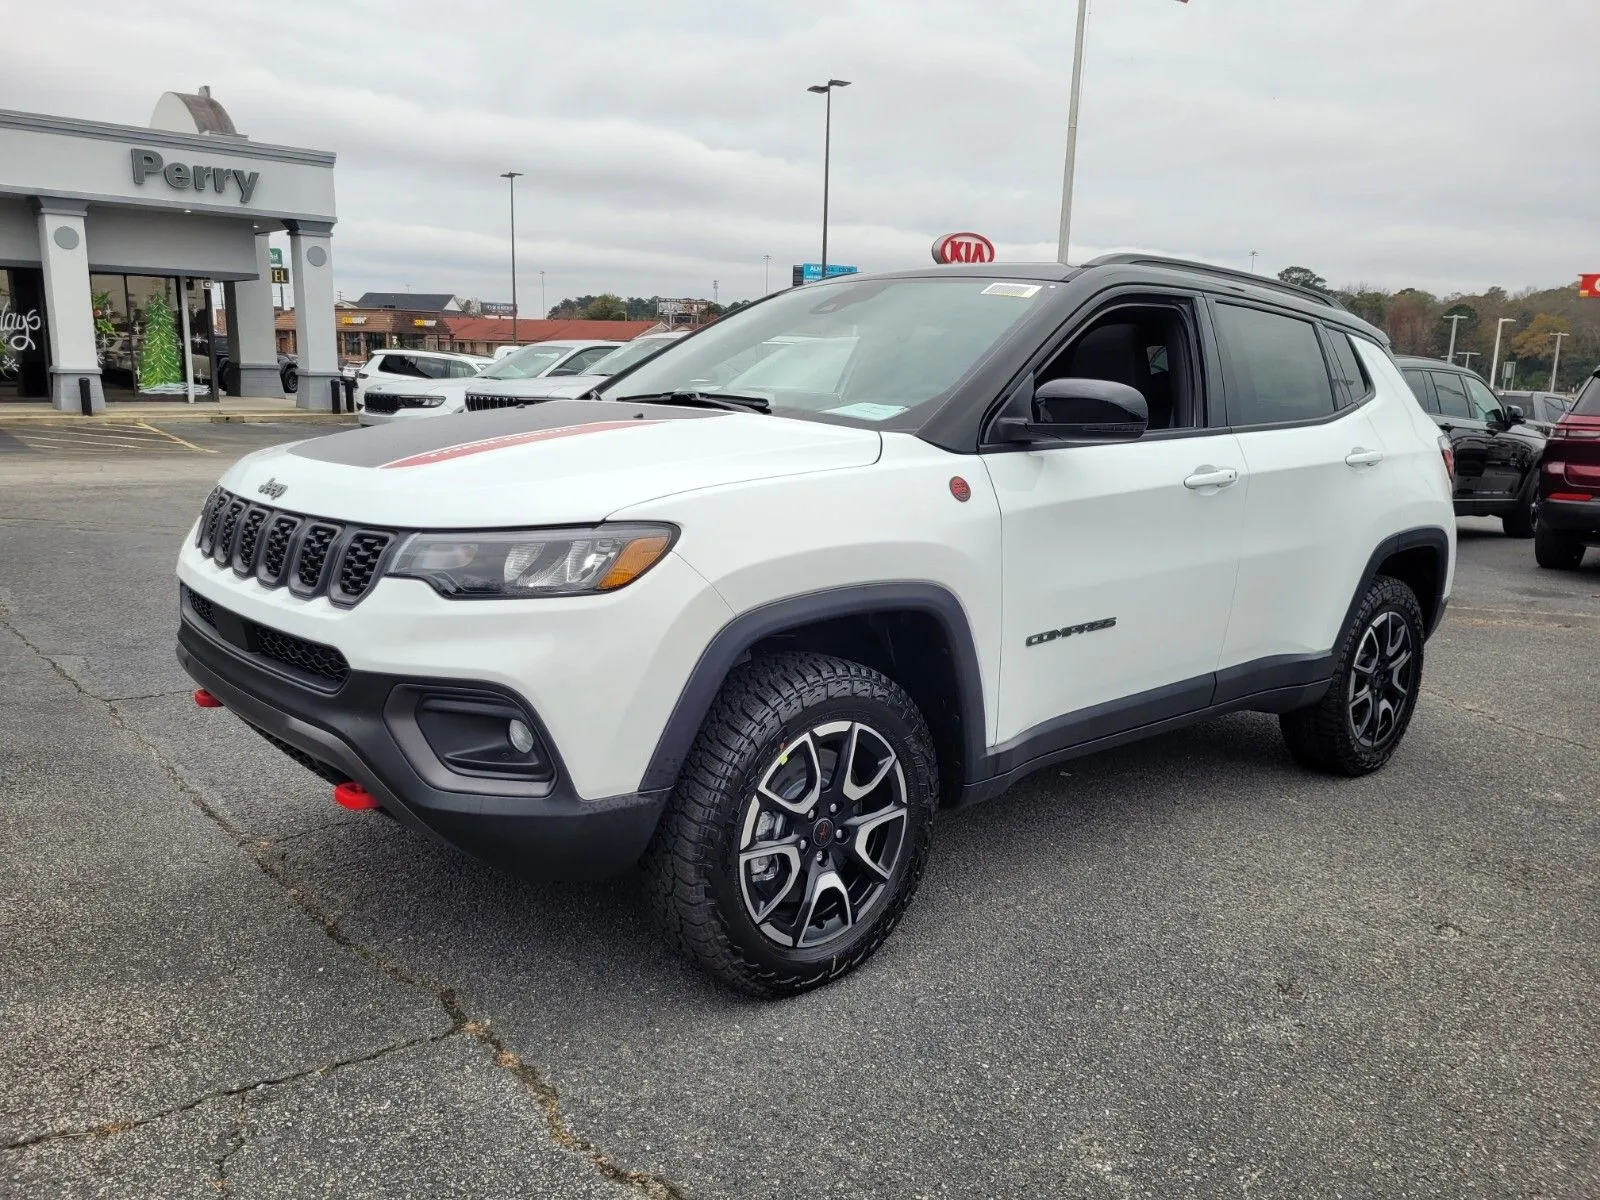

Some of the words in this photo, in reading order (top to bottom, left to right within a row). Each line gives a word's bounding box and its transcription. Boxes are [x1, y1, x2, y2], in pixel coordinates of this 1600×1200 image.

[131, 148, 259, 203] Perry
[950, 241, 986, 263] KIA
[274, 269, 287, 282] EL
[257, 477, 288, 500] Jeep
[1025, 616, 1117, 647] COMPASS
